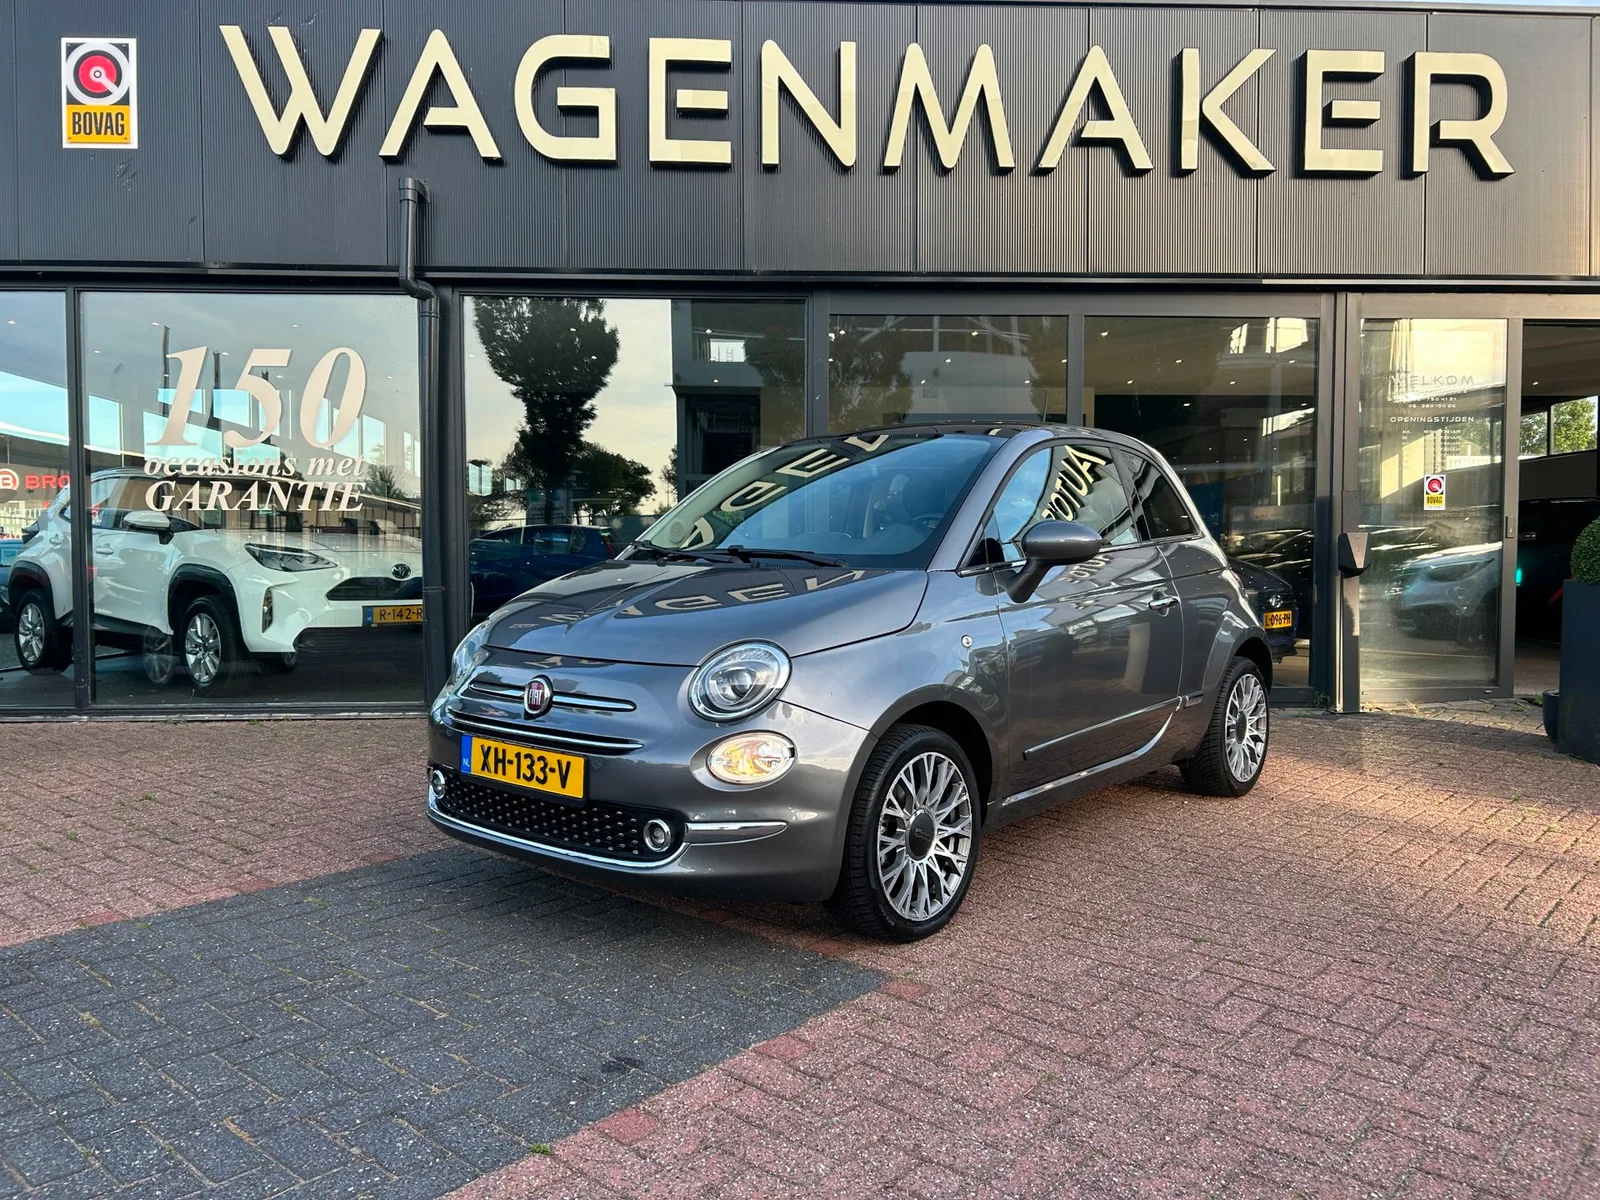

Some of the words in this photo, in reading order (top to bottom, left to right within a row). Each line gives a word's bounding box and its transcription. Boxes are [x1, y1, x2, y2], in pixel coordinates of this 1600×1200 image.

[219, 24, 1515, 175] WAGENMAKER
[72, 112, 125, 136] BOVAG
[146, 346, 366, 449] 150
[144, 449, 298, 477] occasions
[306, 453, 365, 477] met
[145, 480, 366, 512] GARANTIE
[528, 688, 544, 706] FIAT
[480, 744, 572, 789] XH-133-V
